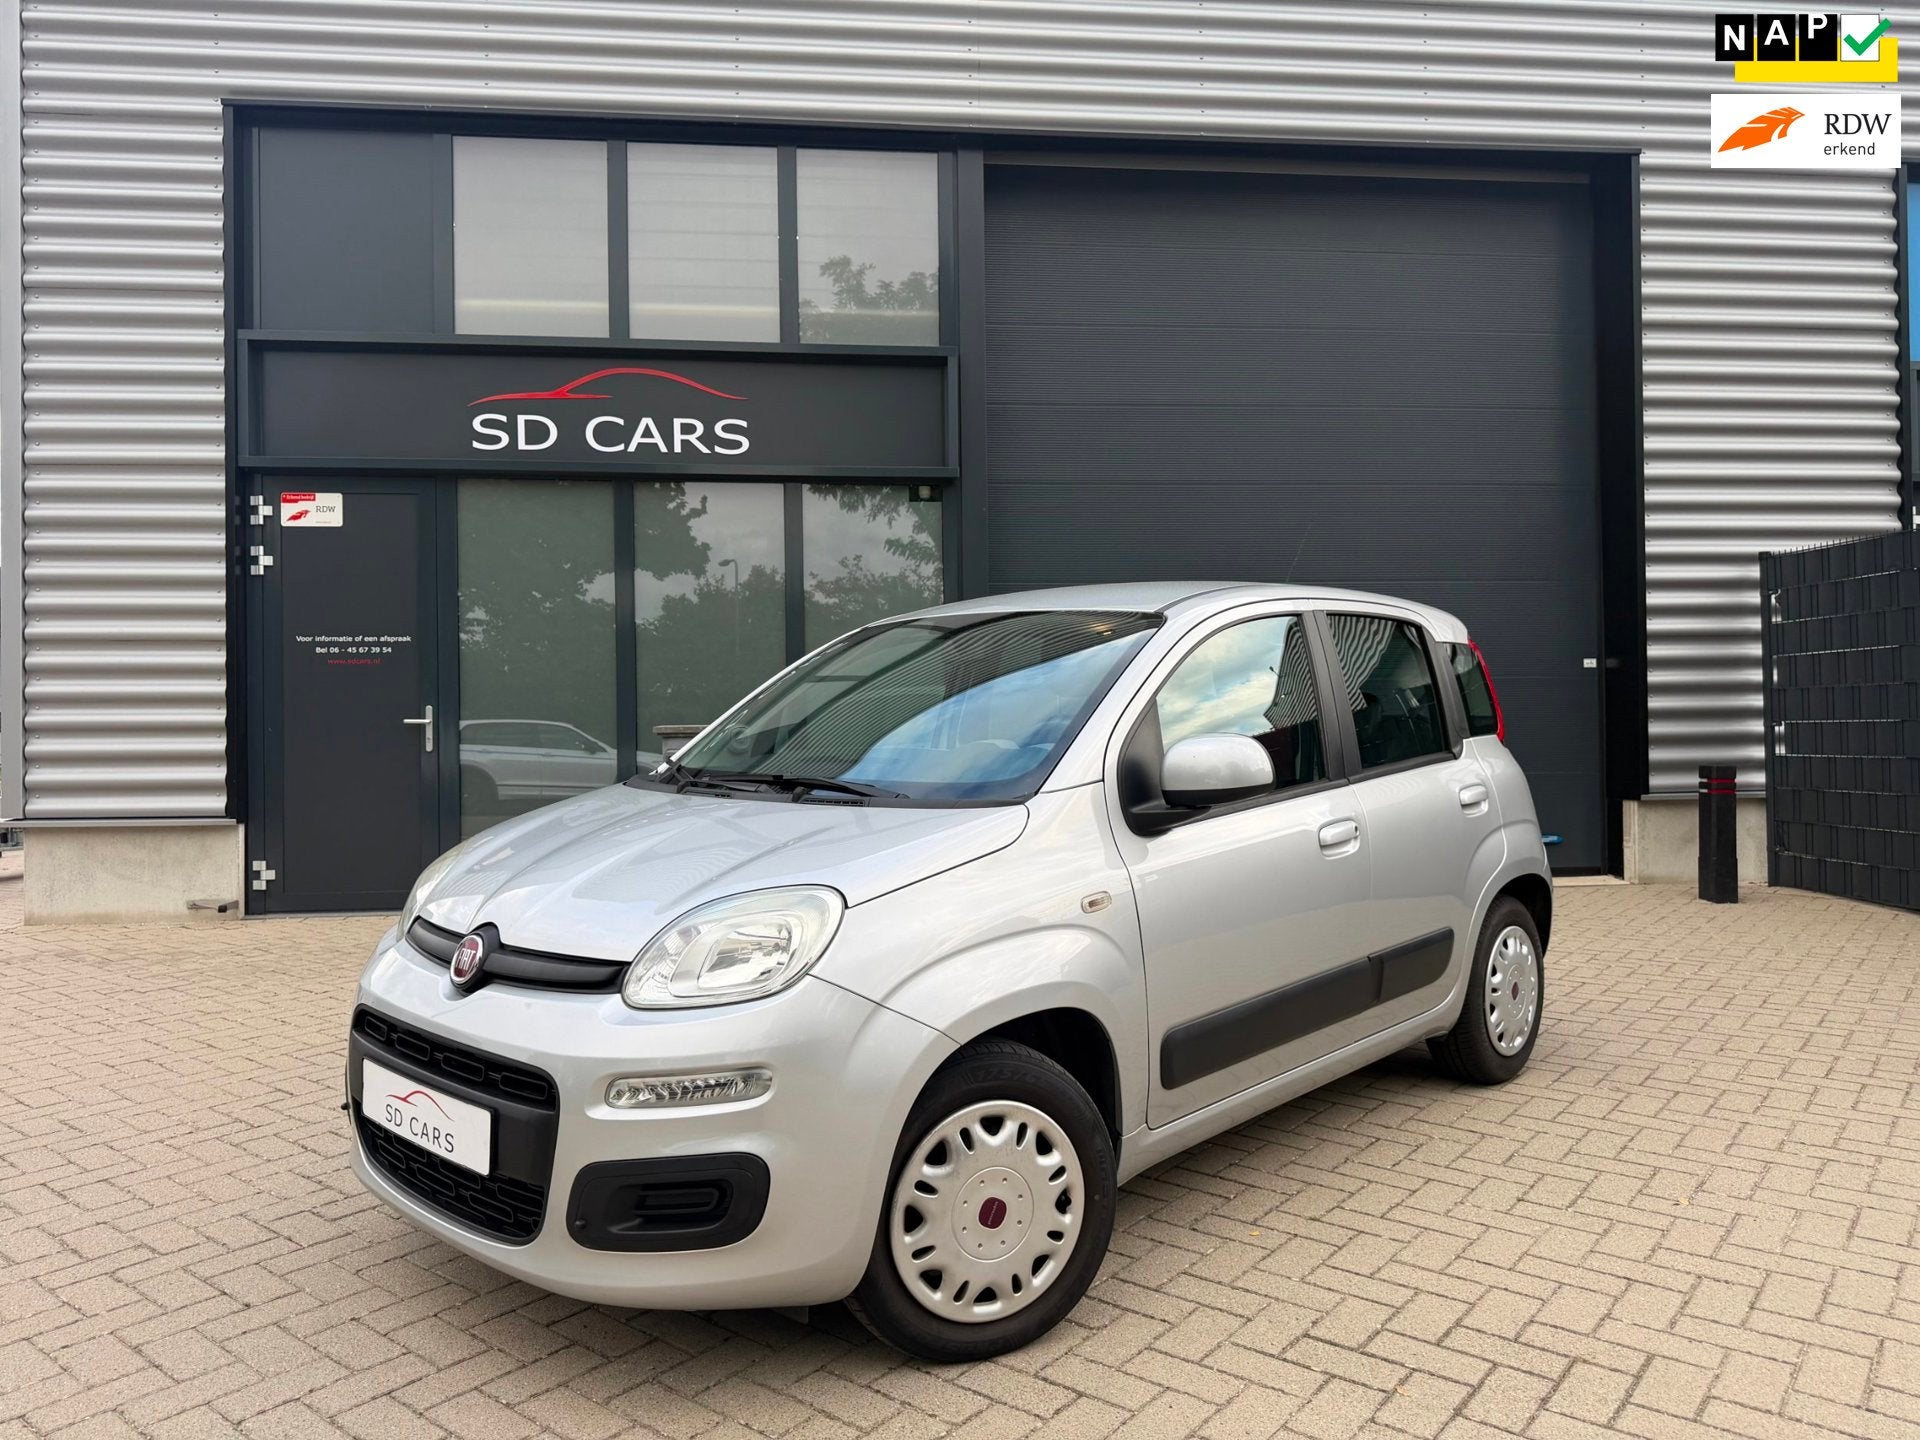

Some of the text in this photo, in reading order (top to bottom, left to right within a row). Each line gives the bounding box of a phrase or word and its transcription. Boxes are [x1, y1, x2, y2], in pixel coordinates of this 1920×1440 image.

[471, 413, 751, 455] SD CARS
[315, 505, 336, 513] RDW
[379, 635, 412, 644] afspraak
[315, 646, 328, 654] Bel
[329, 646, 340, 654] 06
[346, 646, 357, 654] 45
[358, 646, 369, 654] 67
[370, 646, 381, 654] 39
[382, 646, 392, 654] 54
[455, 947, 477, 971] FIAT
[385, 1103, 455, 1154] SD CARS
